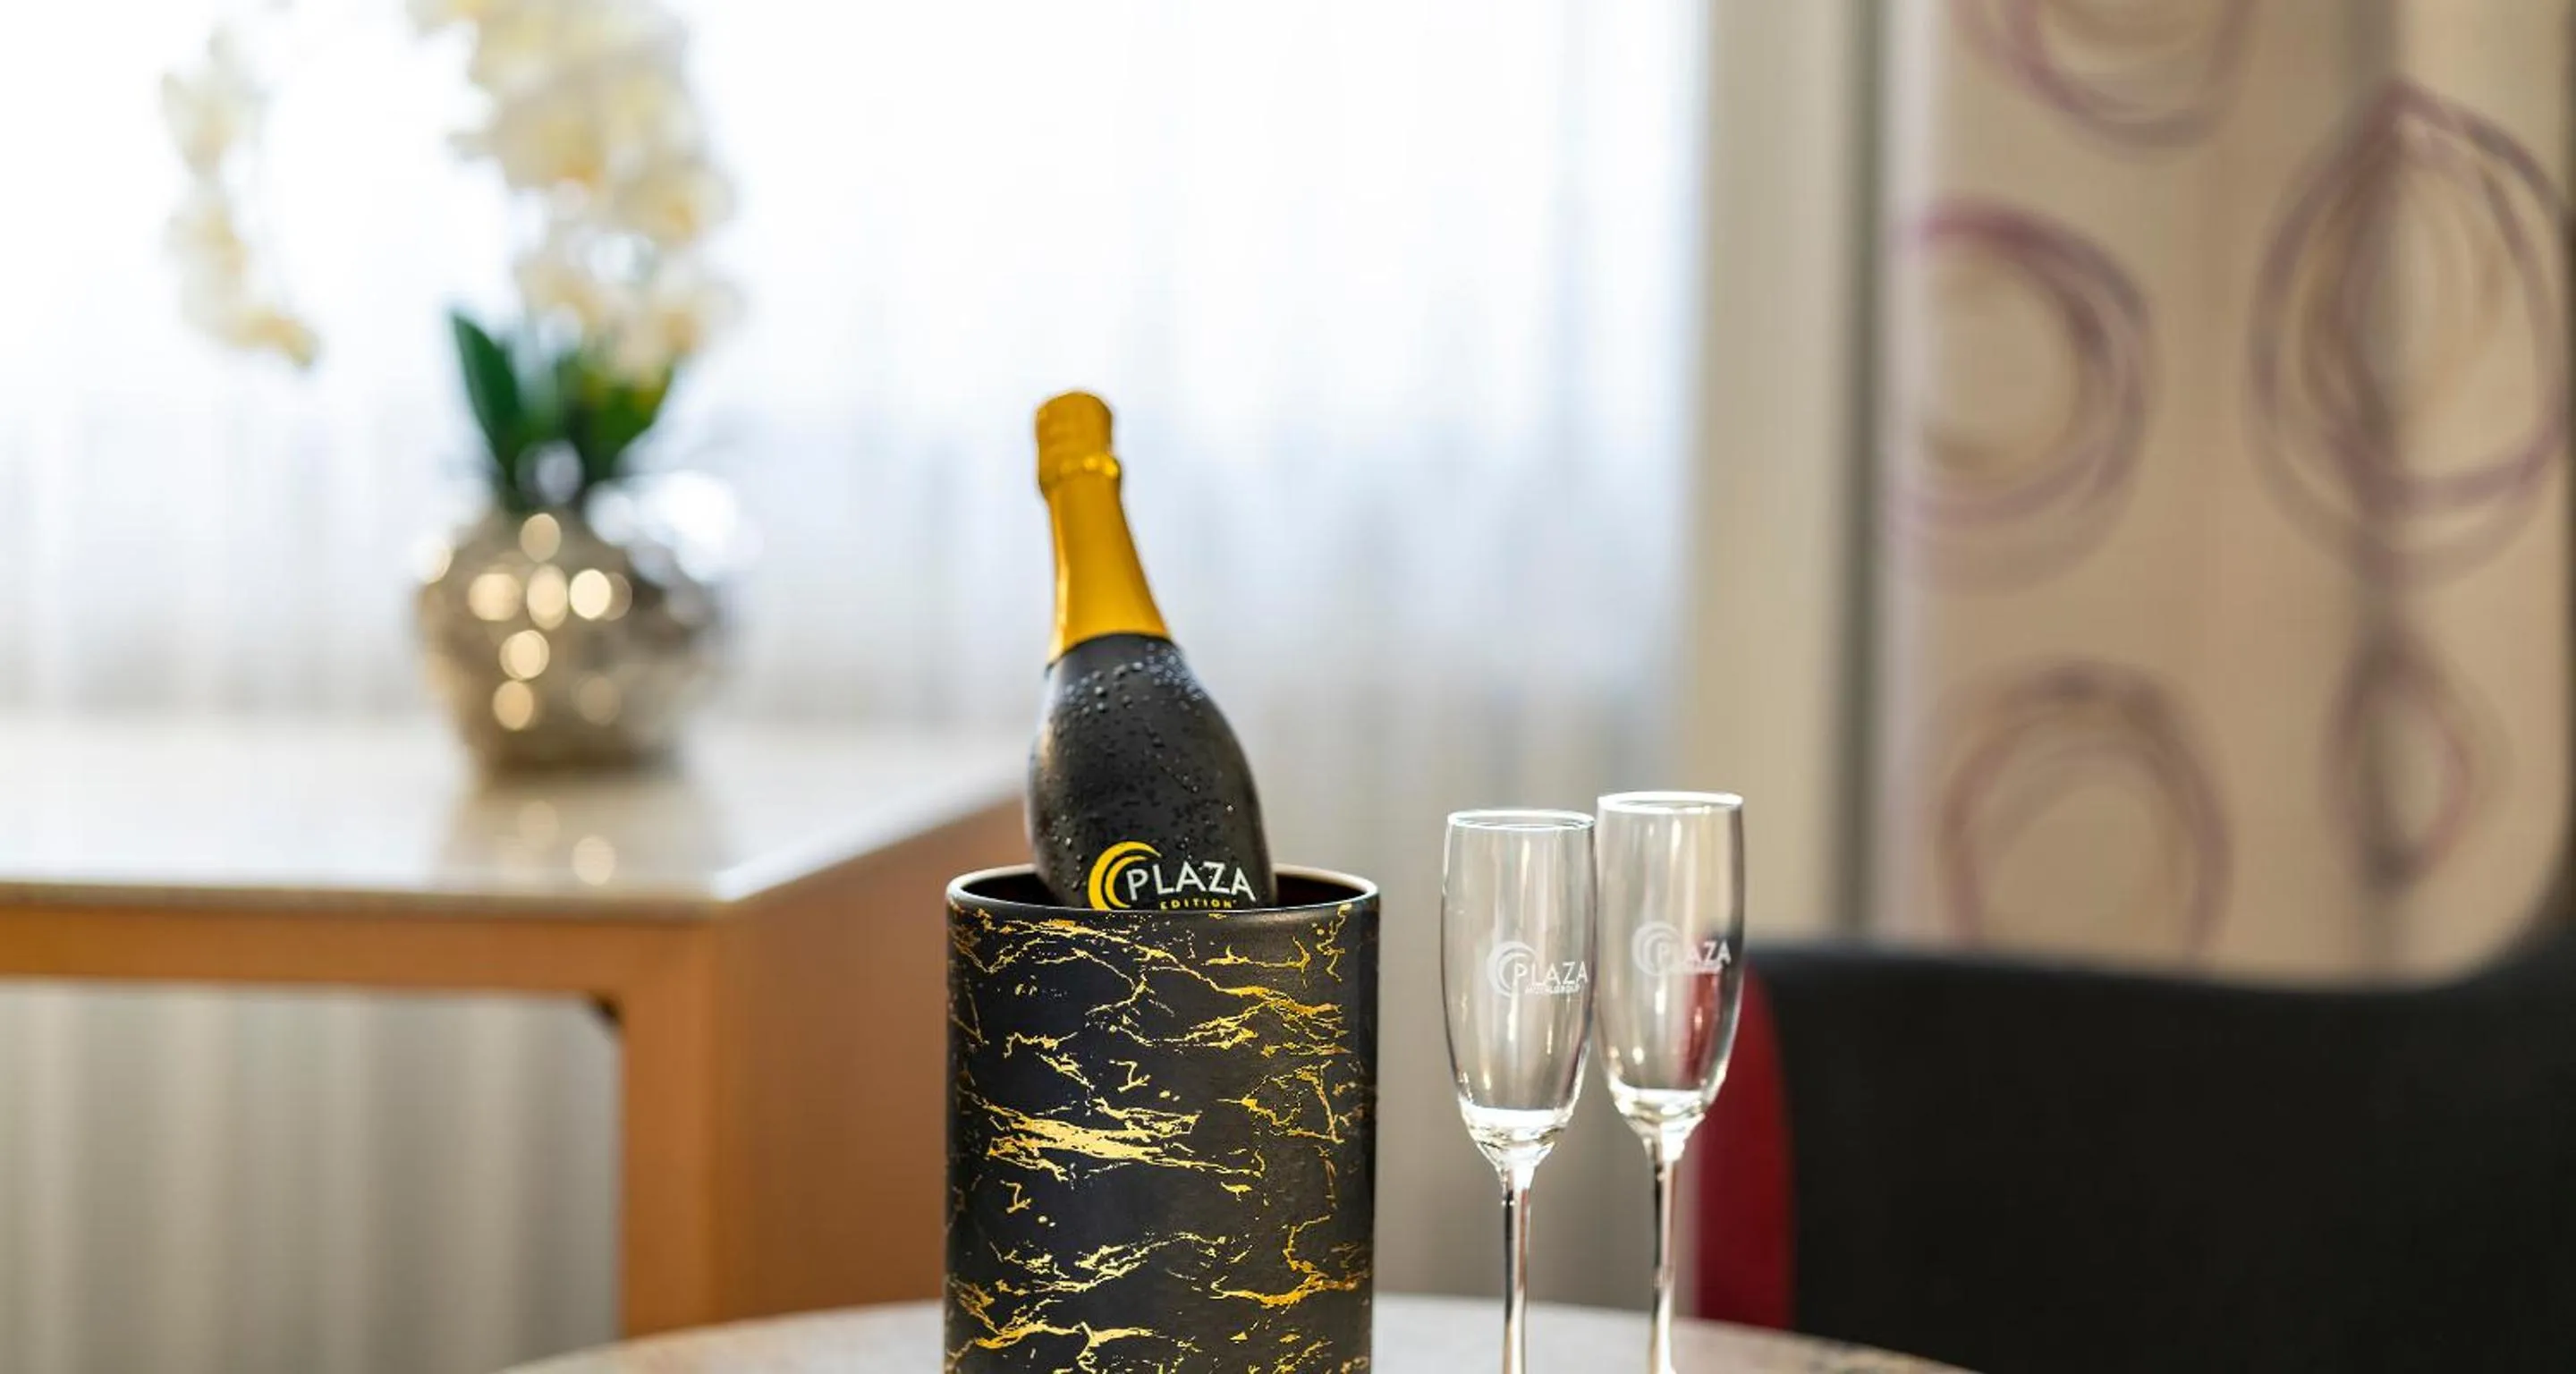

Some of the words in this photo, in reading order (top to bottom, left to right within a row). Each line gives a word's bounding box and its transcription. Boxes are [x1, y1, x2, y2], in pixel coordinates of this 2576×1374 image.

[1126, 861, 1256, 901] PLAZA
[1160, 898, 1233, 910] EDITION
[1513, 961, 1589, 986] PLAZA
